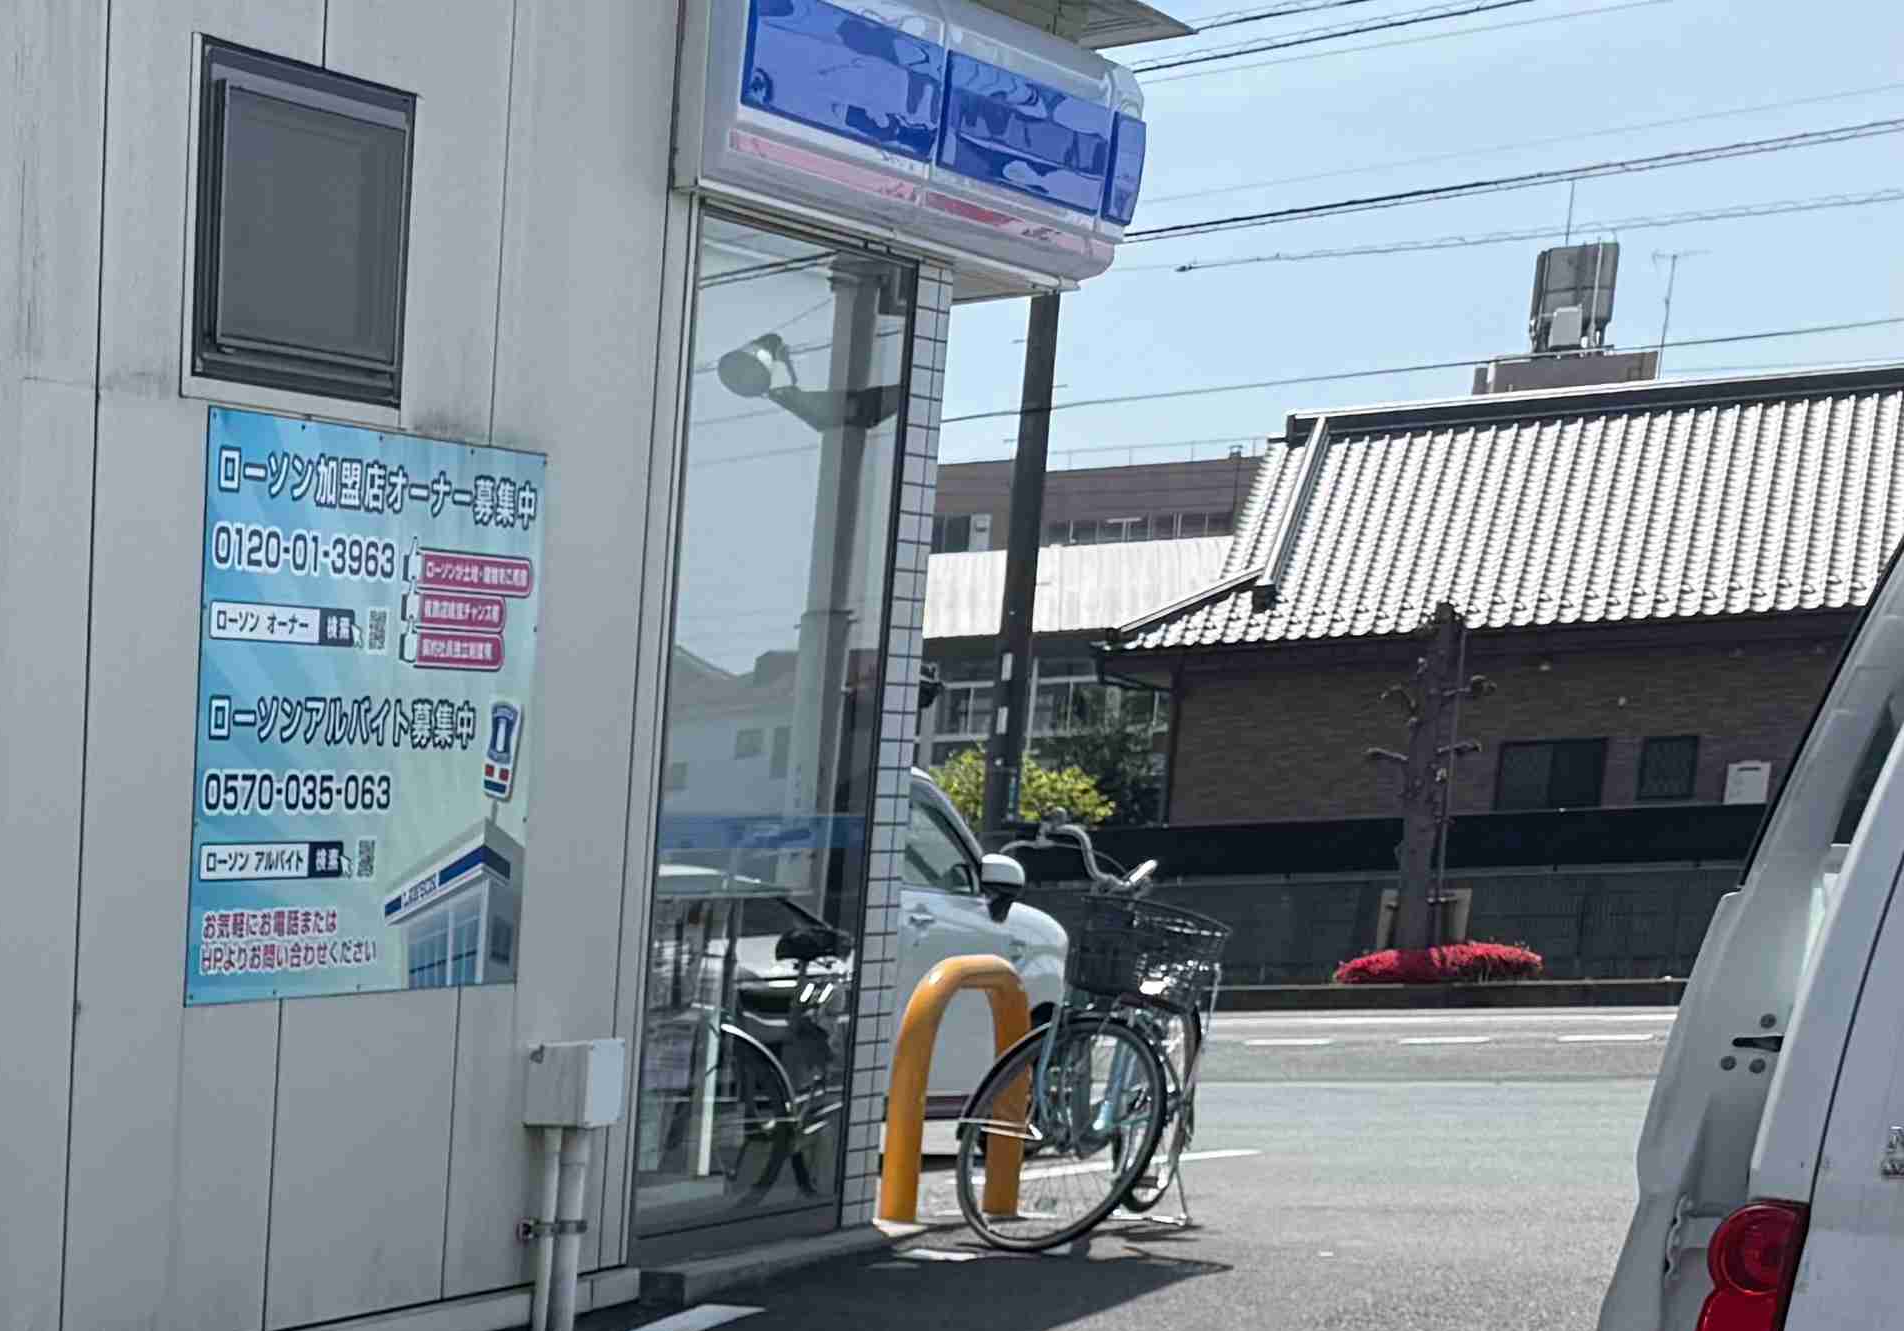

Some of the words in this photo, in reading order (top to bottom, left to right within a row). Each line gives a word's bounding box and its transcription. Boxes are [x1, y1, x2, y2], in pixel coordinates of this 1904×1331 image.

[218, 444, 538, 530] ローソン加盟店オーナー募集中
[214, 524, 396, 579] 0120-01-3963
[217, 609, 260, 632] ローソン
[267, 612, 309, 635] オーナー
[208, 695, 476, 750] ローソンアルバイト募集中
[204, 773, 391, 811] 0570-035-063
[206, 853, 249, 873] ローソン
[255, 850, 303, 872] アルバイト
[203, 910, 337, 938] お気軽にお電話または
